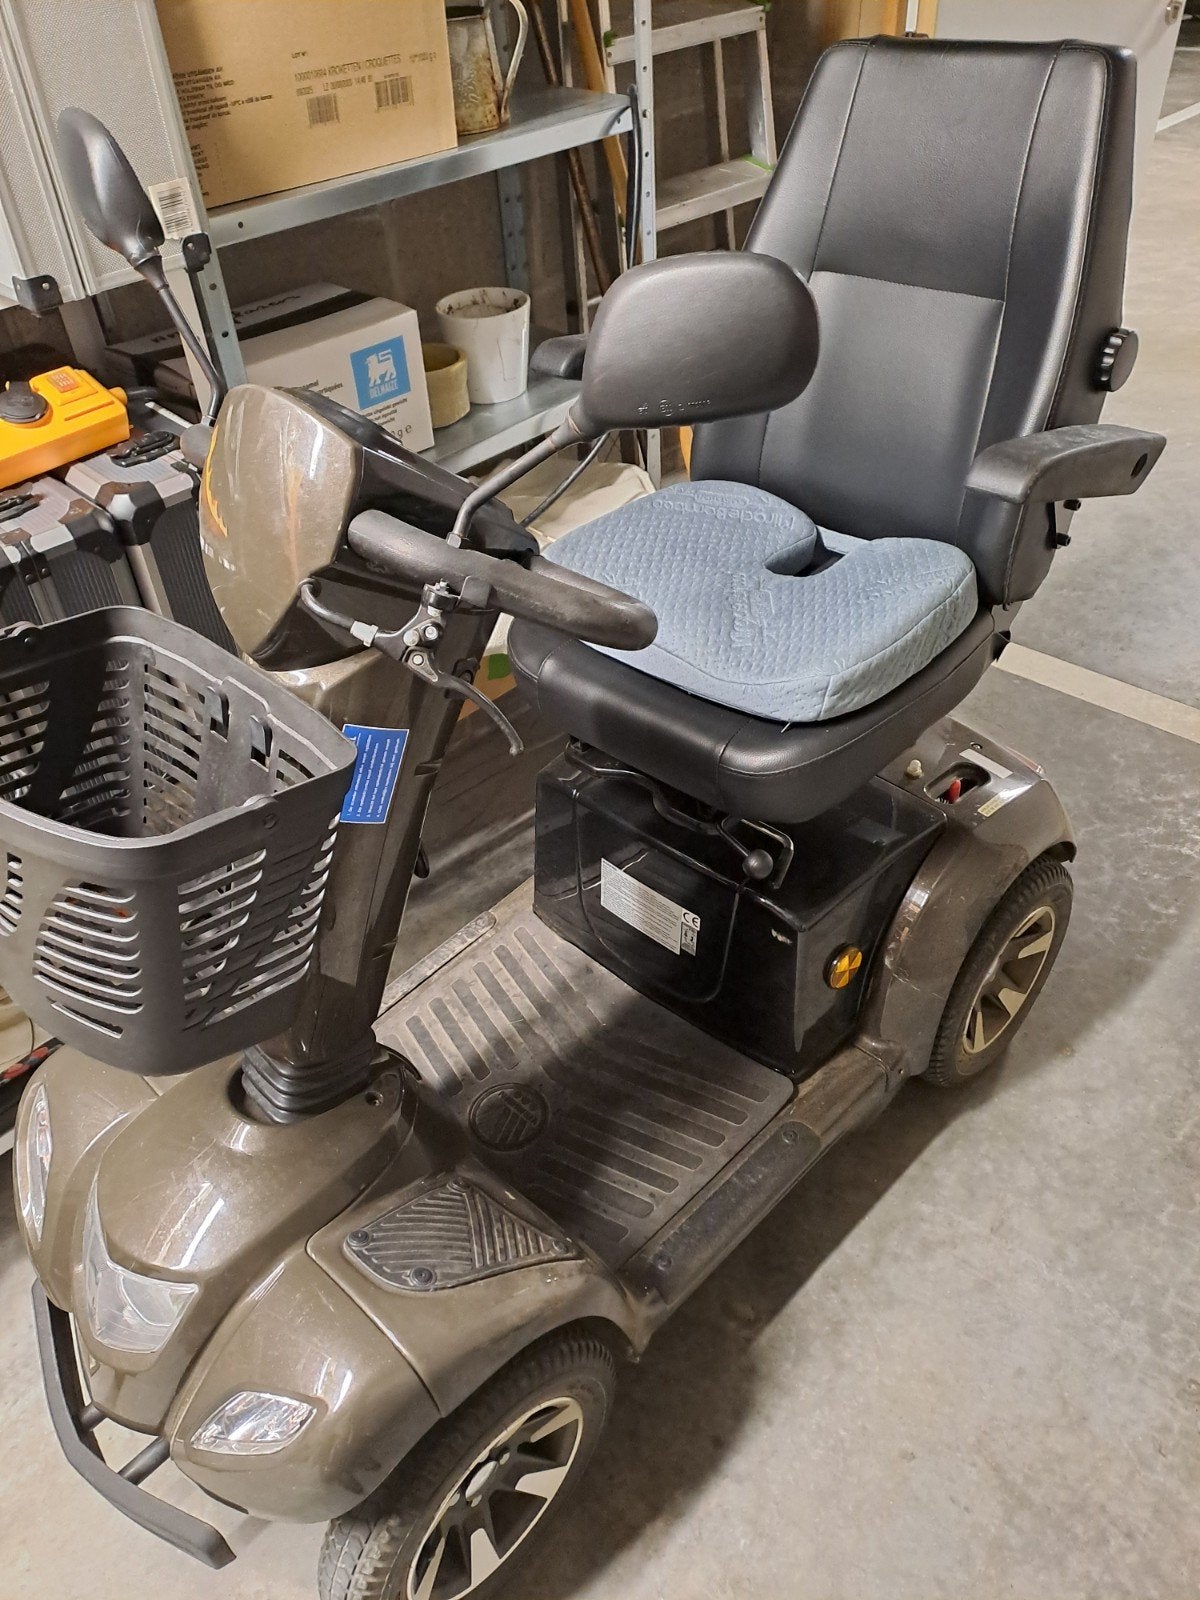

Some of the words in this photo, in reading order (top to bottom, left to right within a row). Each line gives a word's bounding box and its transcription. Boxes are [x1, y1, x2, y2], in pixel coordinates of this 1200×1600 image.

[328, 61, 361, 76] KROKETTEN
[364, 53, 401, 69] CROQUETTES
[370, 380, 398, 399] DELHAIZE
